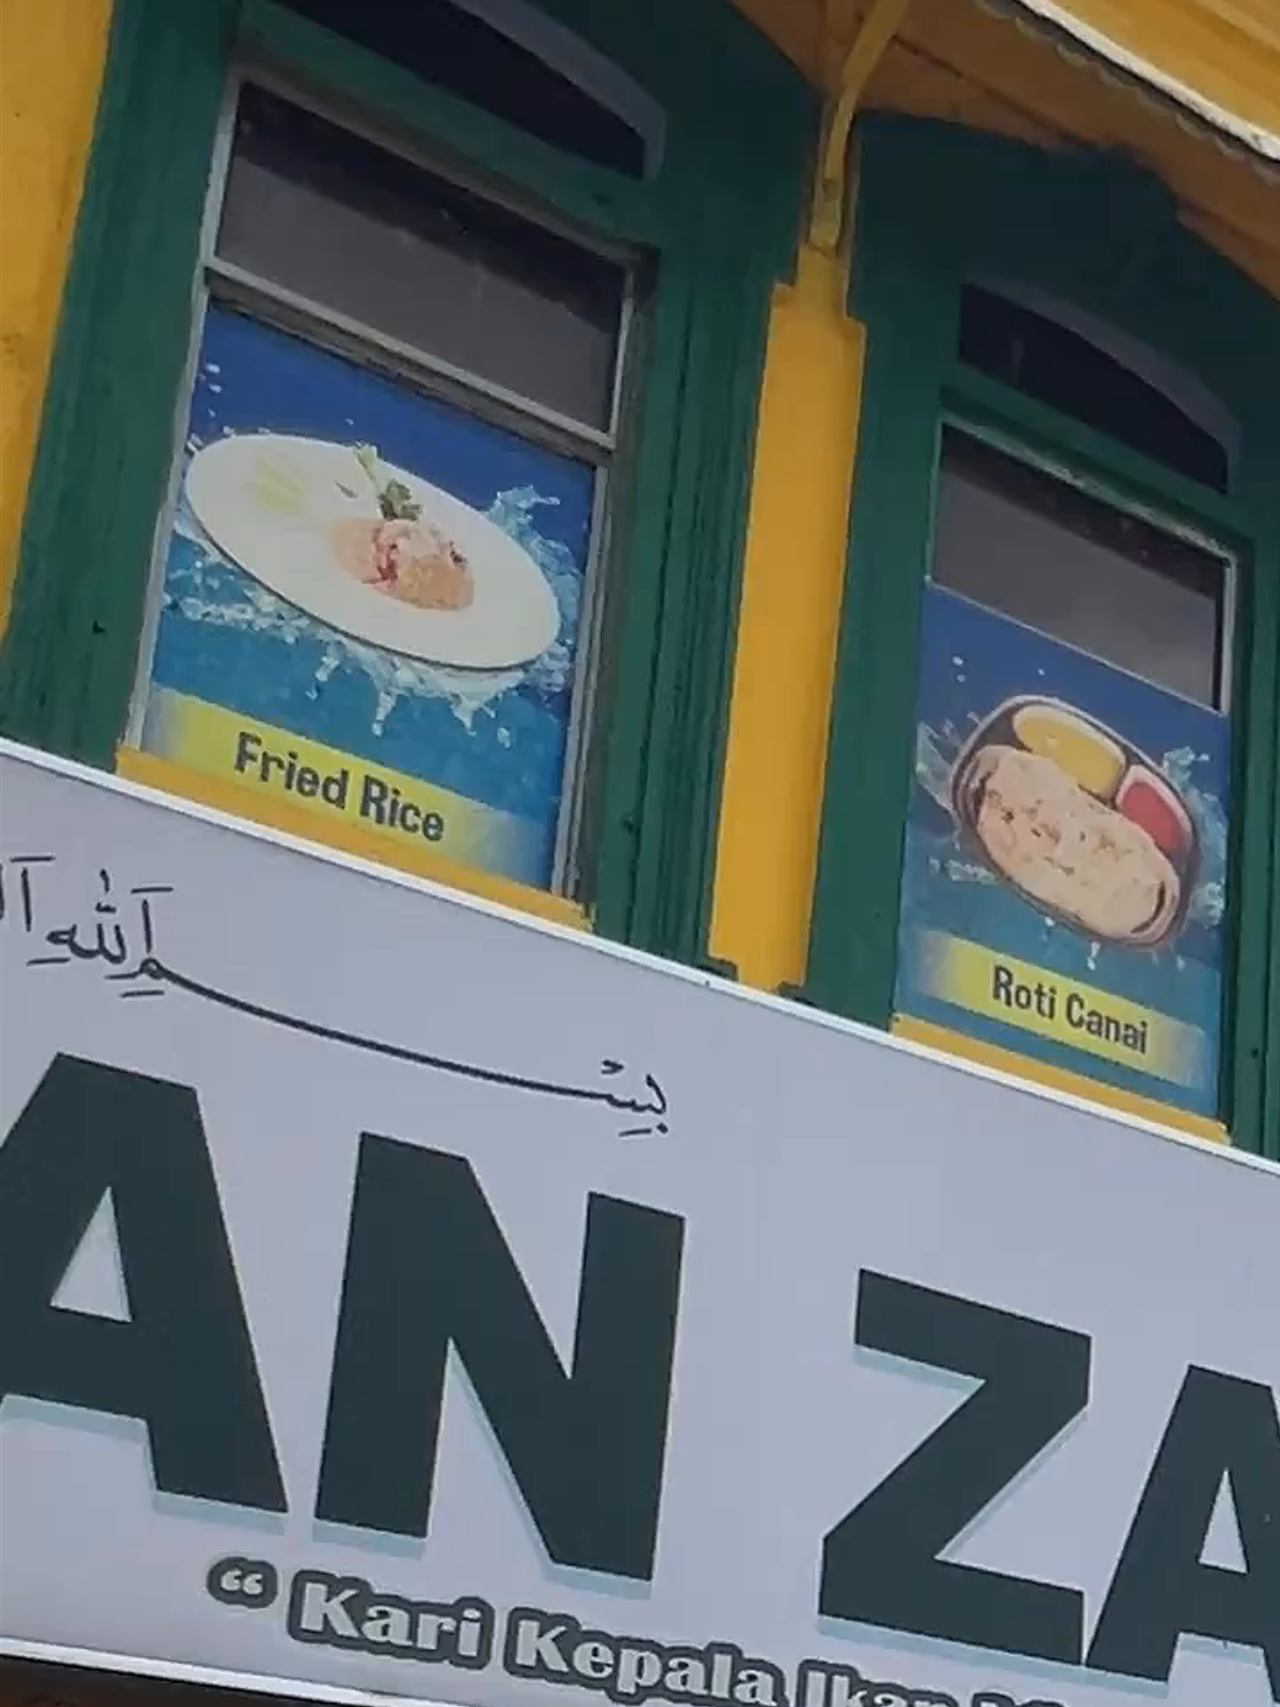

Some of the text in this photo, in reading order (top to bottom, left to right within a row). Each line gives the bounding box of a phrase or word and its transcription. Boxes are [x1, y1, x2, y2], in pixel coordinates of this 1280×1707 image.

[234, 730, 446, 843] Fried Rice
[991, 963, 1148, 1056] Roti Canai
